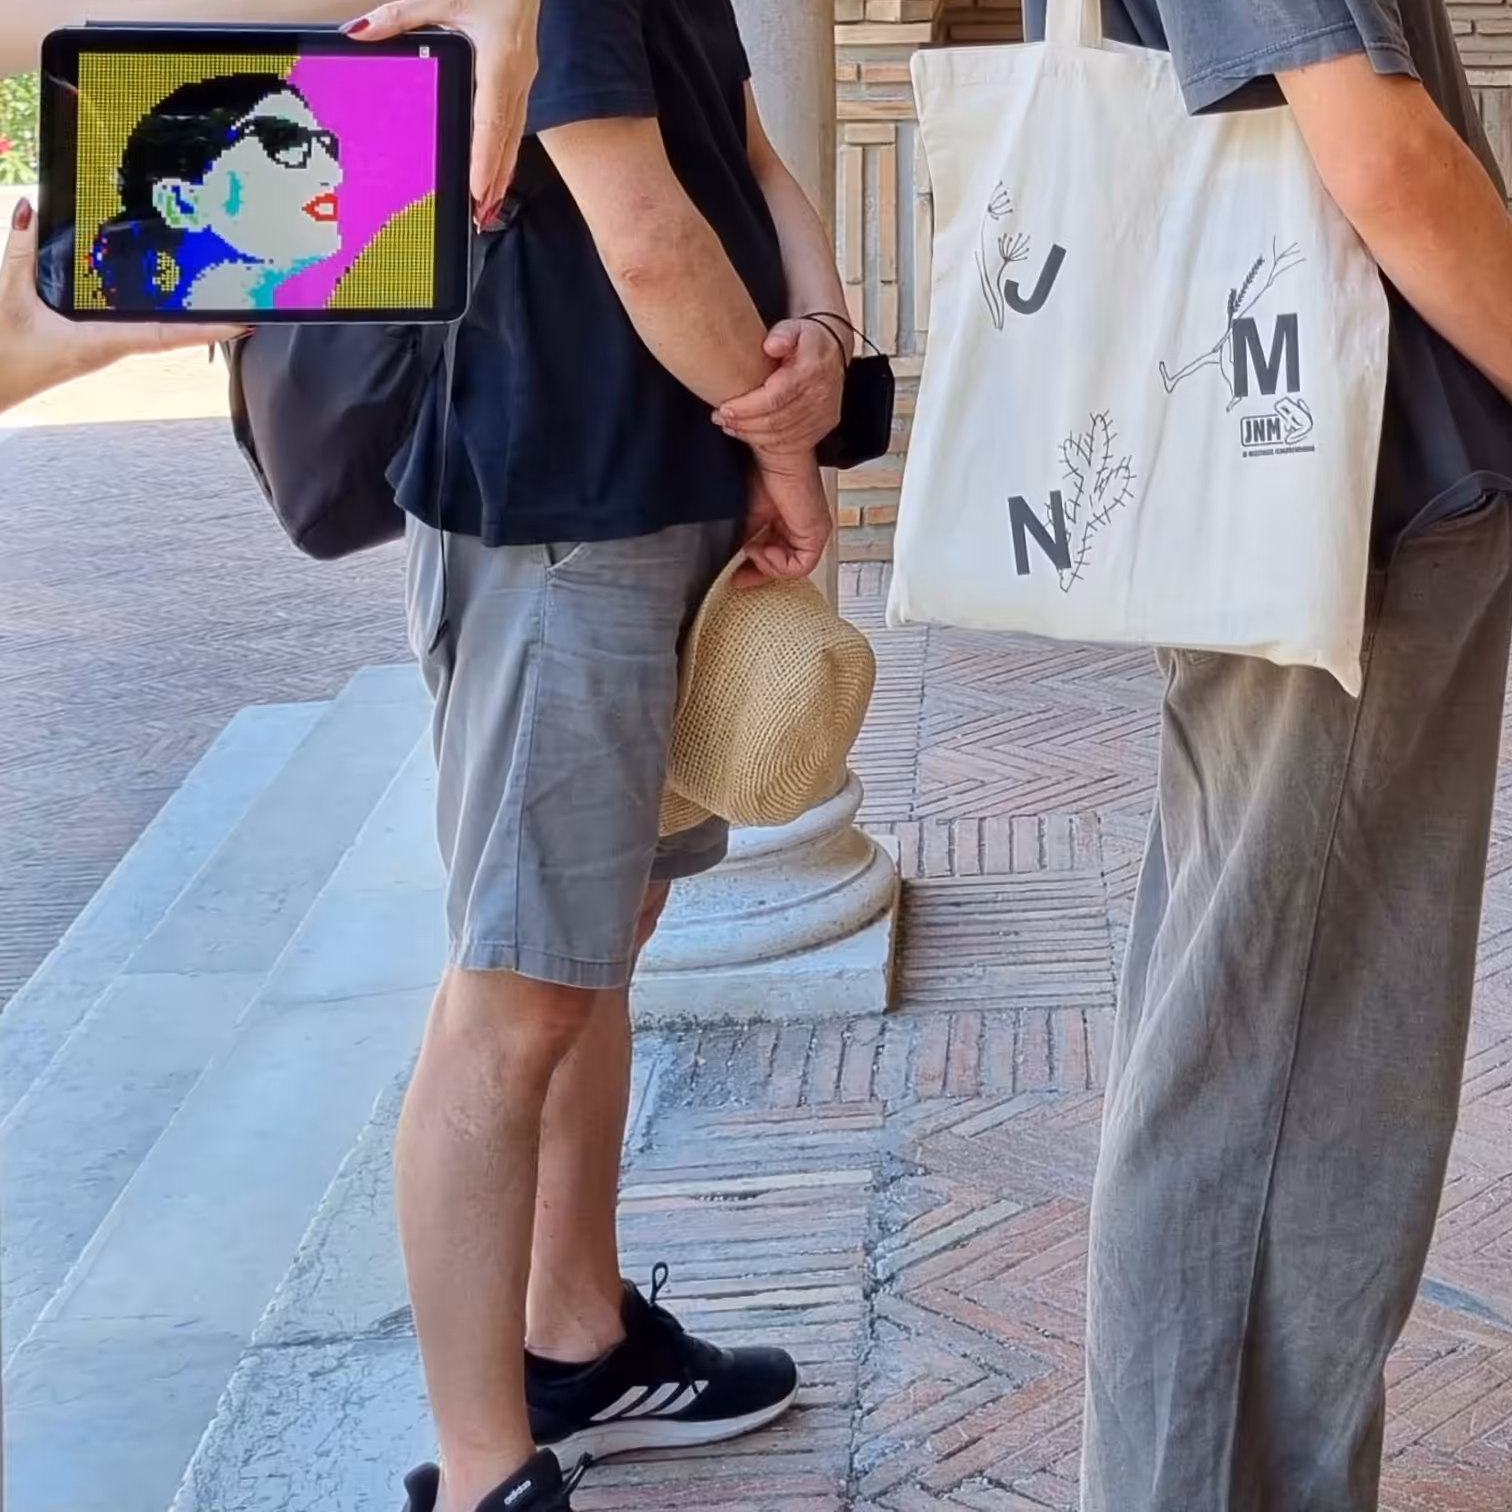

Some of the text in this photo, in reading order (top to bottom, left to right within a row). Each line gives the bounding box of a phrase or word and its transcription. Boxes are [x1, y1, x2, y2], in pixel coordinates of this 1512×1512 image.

[1004, 244, 1066, 314] J
[1232, 313, 1300, 397] M
[1245, 417, 1281, 443] JNM
[1008, 489, 1071, 575] N
